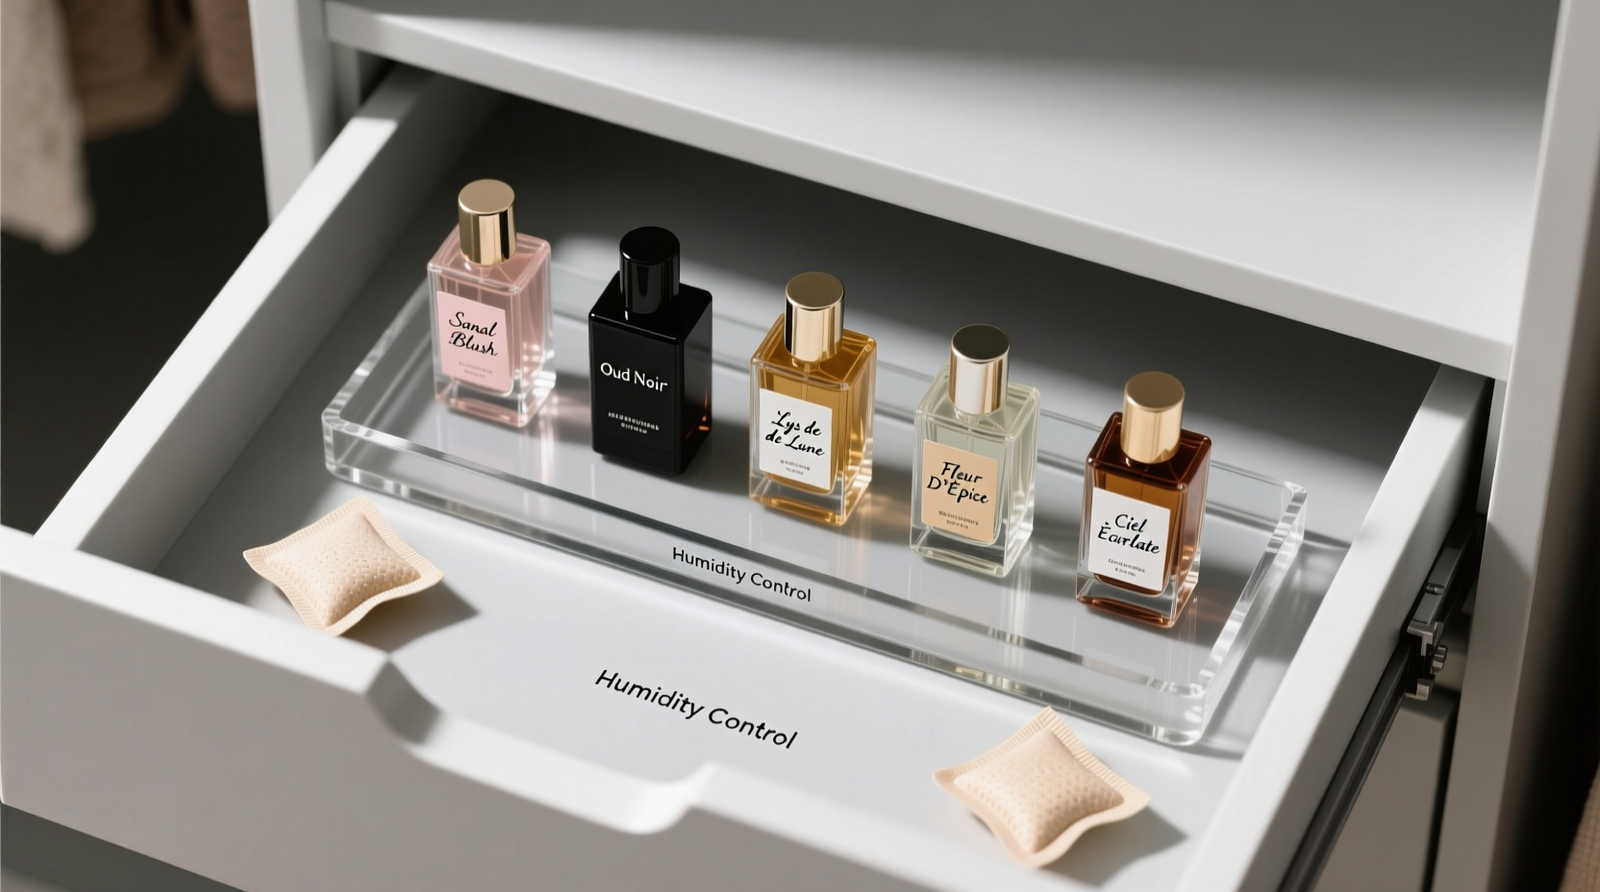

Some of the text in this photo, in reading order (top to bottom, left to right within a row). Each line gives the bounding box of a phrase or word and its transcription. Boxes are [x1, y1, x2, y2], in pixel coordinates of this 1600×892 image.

[449, 331, 498, 356] Blush
[600, 362, 668, 392] Oud Noir
[771, 410, 822, 436] Lys de
[765, 429, 825, 456] de Lune
[941, 461, 983, 483] Fleur
[1115, 513, 1148, 533] Ciel
[672, 547, 811, 602] Humidity Control
[594, 669, 798, 749] Humidity Control
